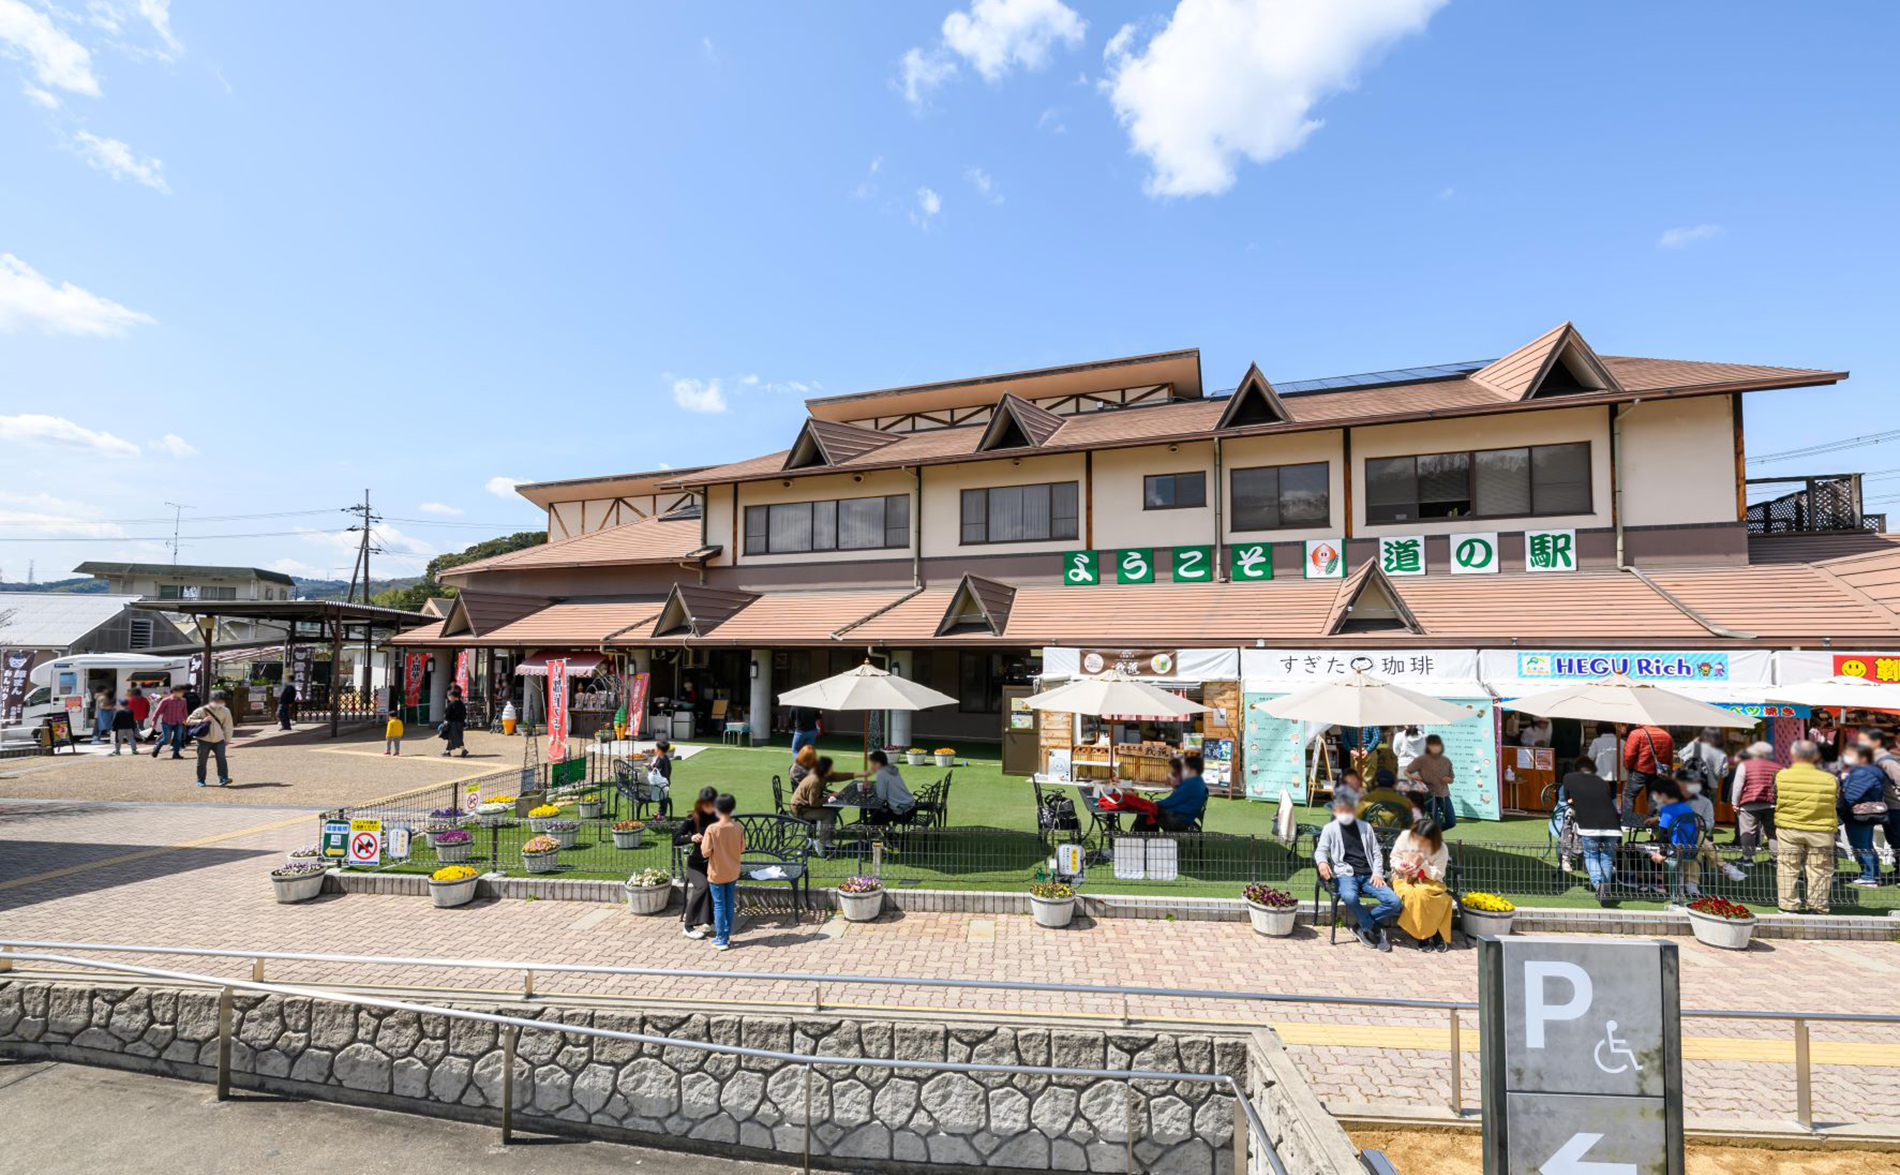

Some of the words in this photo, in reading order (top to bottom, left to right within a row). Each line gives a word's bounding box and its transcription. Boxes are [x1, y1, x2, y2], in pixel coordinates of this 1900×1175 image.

[1068, 546, 1266, 582] ようこそ
[1384, 533, 1572, 573] 道の駅
[1280, 655, 1345, 674] すぎた
[1381, 655, 1434, 675] 珈琲
[1556, 658, 1629, 675] HEGU
[1636, 657, 1692, 676] Rich
[1525, 961, 1593, 1049] P
